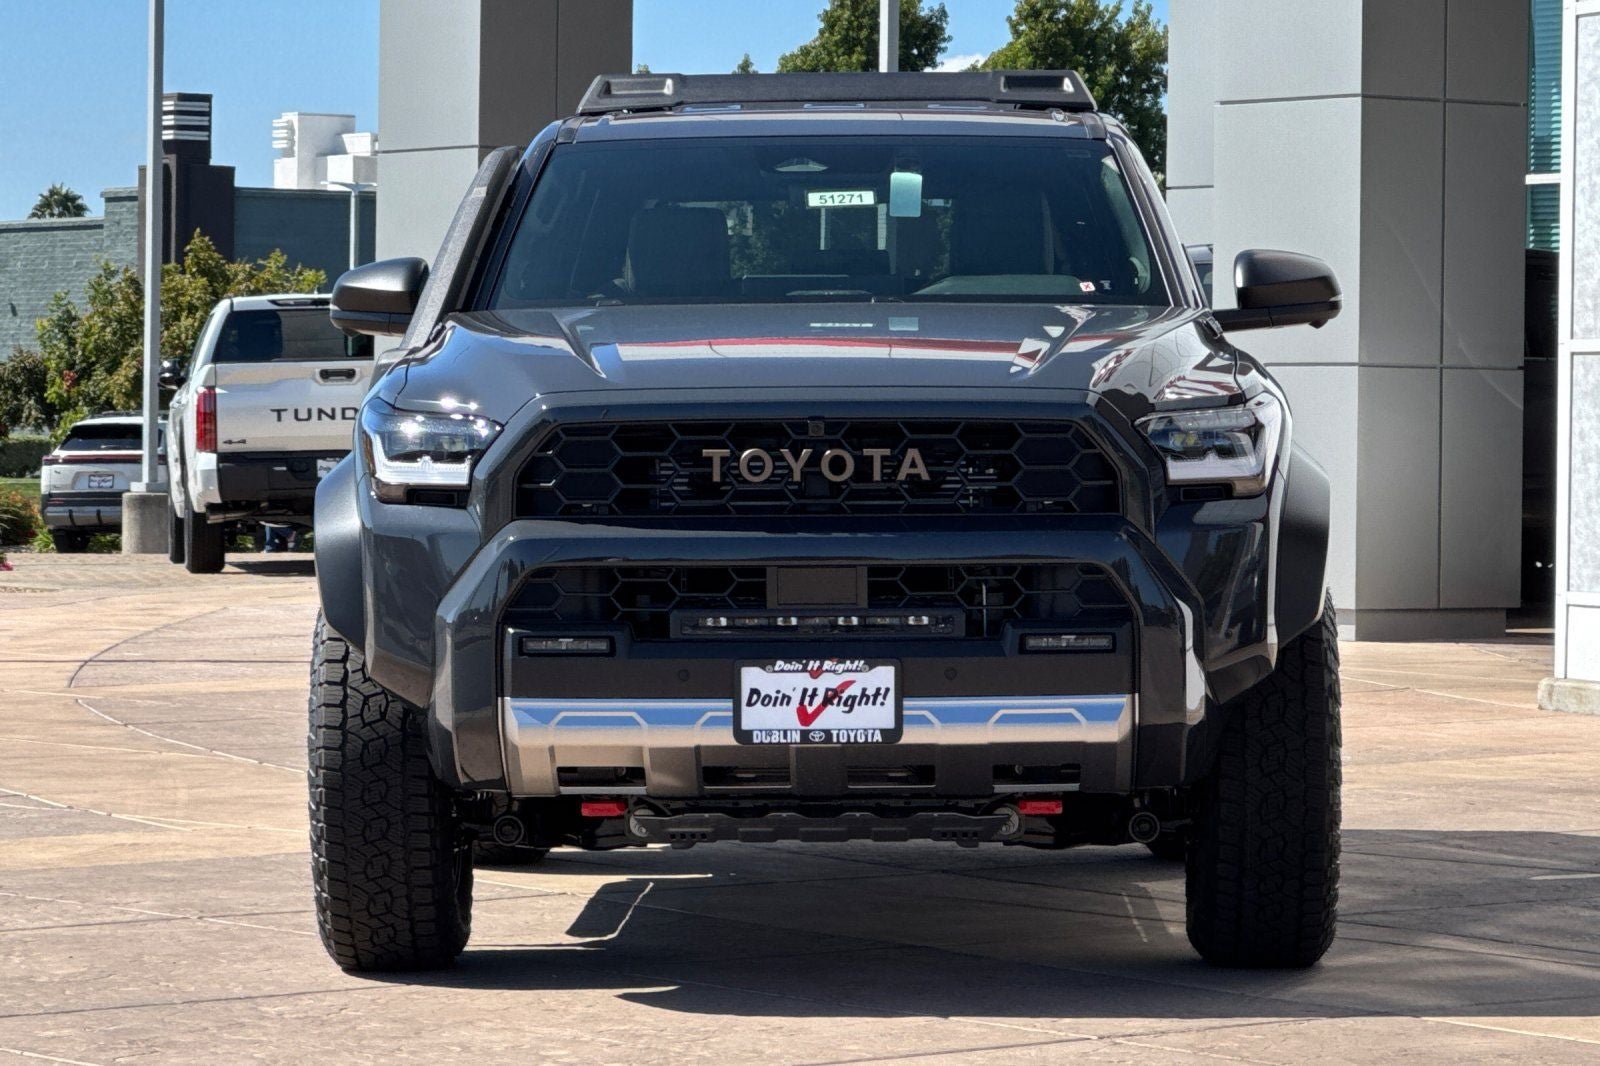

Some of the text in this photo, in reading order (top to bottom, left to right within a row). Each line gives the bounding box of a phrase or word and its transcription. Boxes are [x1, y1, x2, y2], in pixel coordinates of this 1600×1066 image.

[819, 194, 864, 205] 51271
[270, 407, 359, 422] TUND
[702, 448, 931, 482] TOYOTA
[774, 660, 865, 674] Doin' It Right!
[746, 687, 890, 713] Doin' It Right!
[752, 730, 882, 743] DUBLIN TOYOTA
